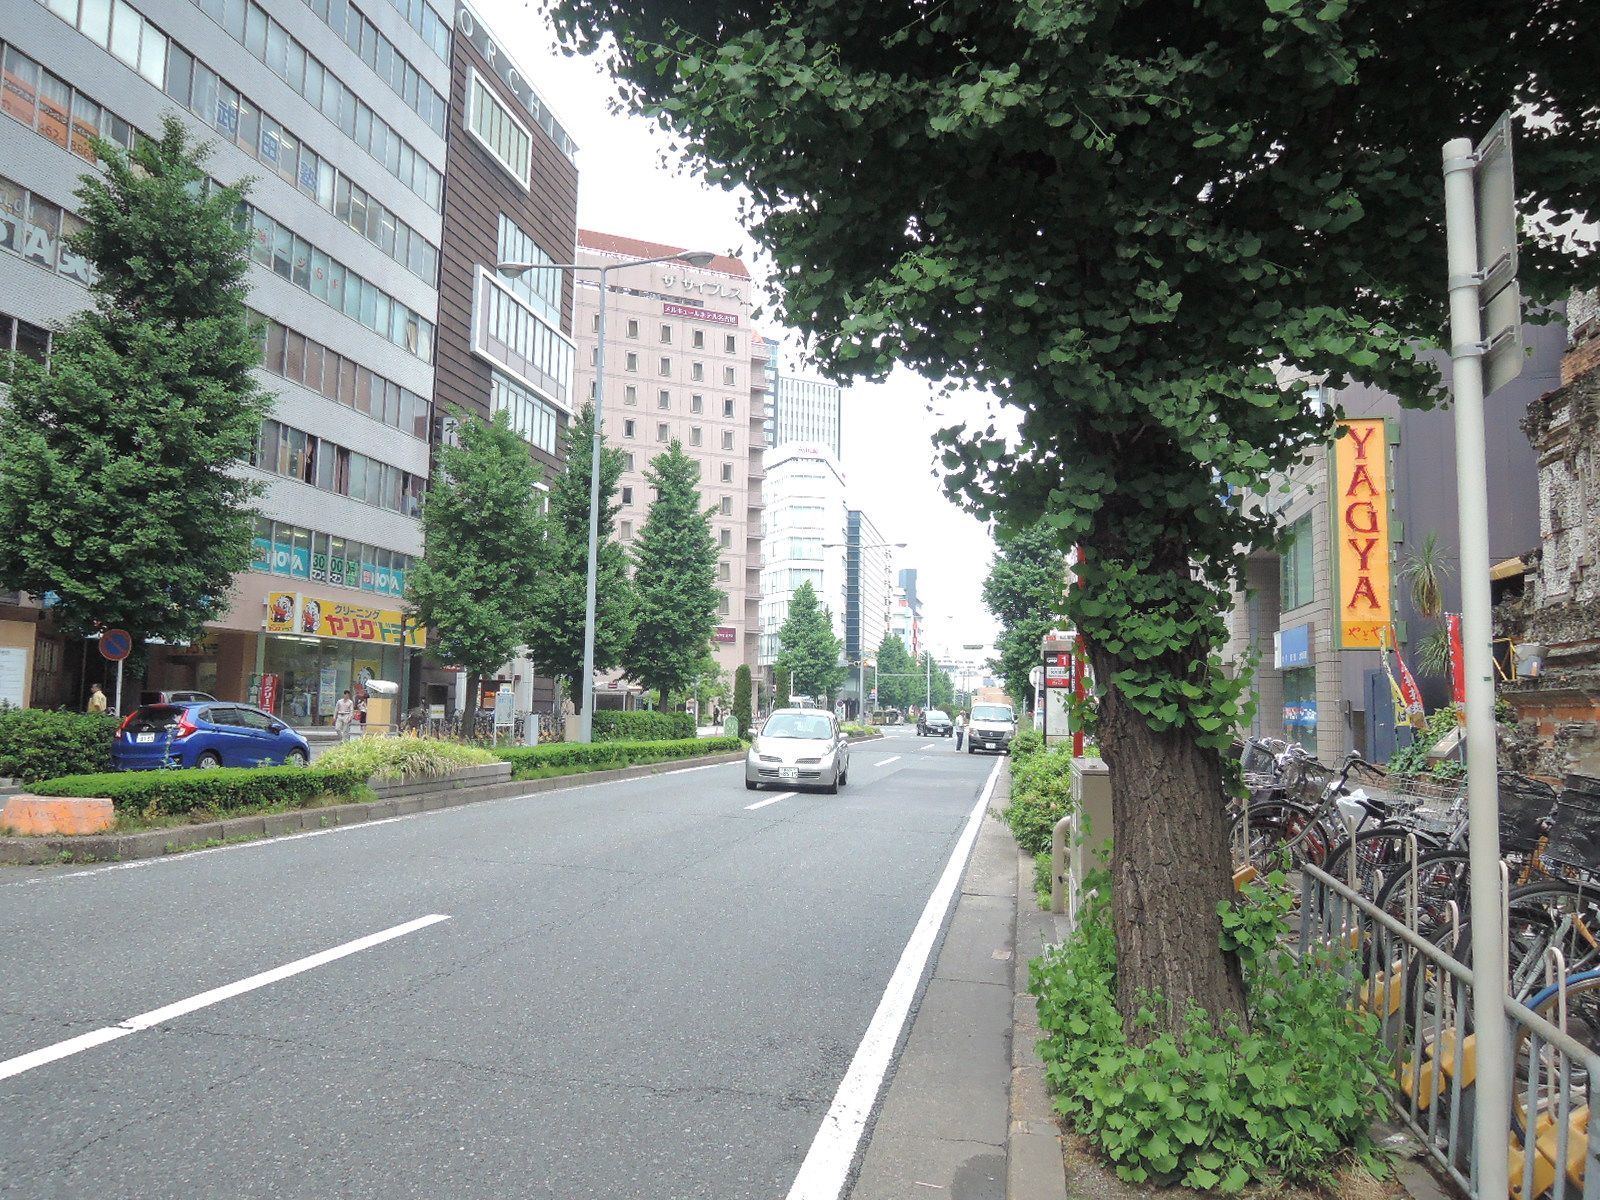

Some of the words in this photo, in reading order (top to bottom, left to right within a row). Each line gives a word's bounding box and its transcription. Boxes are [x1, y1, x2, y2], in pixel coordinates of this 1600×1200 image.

[460, 8, 573, 158] ORCHID
[682, 278, 742, 301] サイプレス
[1346, 428, 1381, 609] YAGYA
[334, 604, 381, 620] クリーニング
[325, 614, 416, 645] ヤングドライ
[1061, 656, 1067, 666] 1
